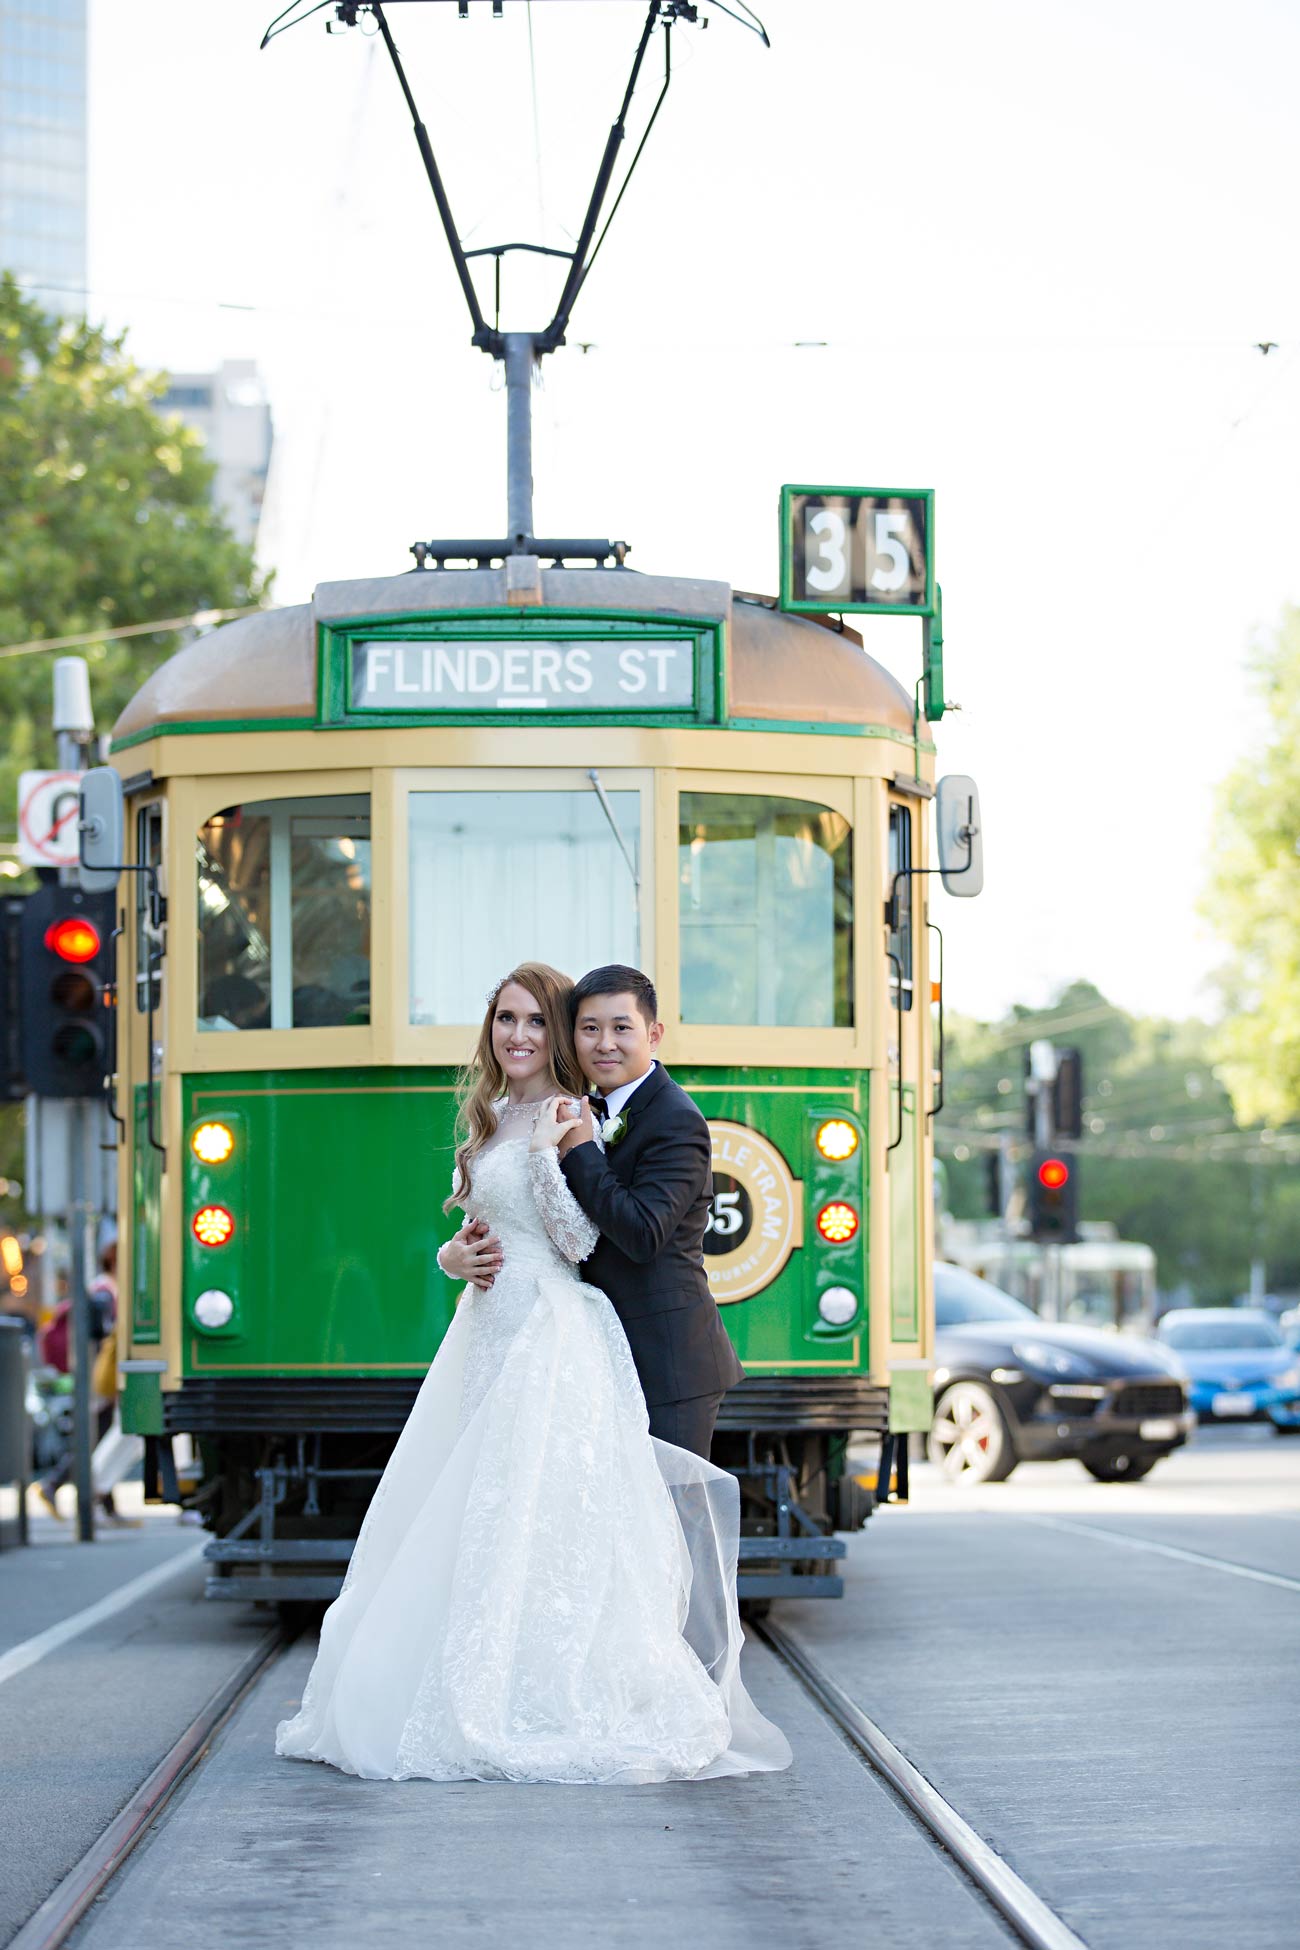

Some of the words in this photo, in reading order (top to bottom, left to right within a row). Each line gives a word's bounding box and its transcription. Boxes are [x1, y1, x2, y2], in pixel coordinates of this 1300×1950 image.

[807, 511, 909, 591] 35
[366, 648, 594, 694] FLINDERS
[617, 648, 677, 694] ST
[711, 1137, 752, 1168] CLE
[751, 1158, 782, 1239] TRAM
[710, 1254, 759, 1283] OURNE
